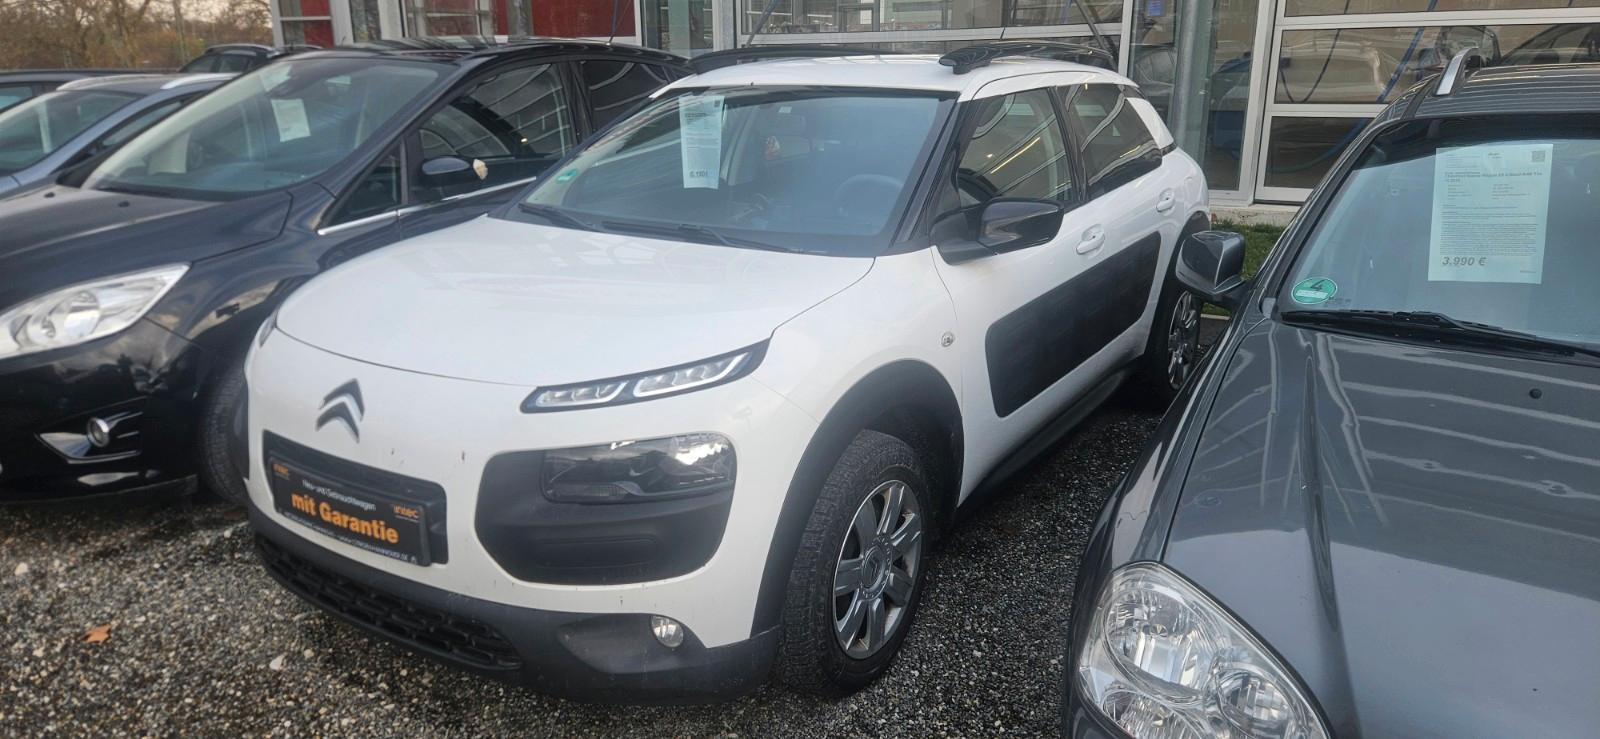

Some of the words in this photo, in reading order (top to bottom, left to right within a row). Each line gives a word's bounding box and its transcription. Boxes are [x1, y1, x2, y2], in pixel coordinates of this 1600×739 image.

[1442, 256, 1475, 267] 3.990
[1478, 256, 1487, 267] €
[1310, 279, 1325, 291] 4
[291, 493, 317, 517] mit
[318, 501, 399, 544] Garantie
